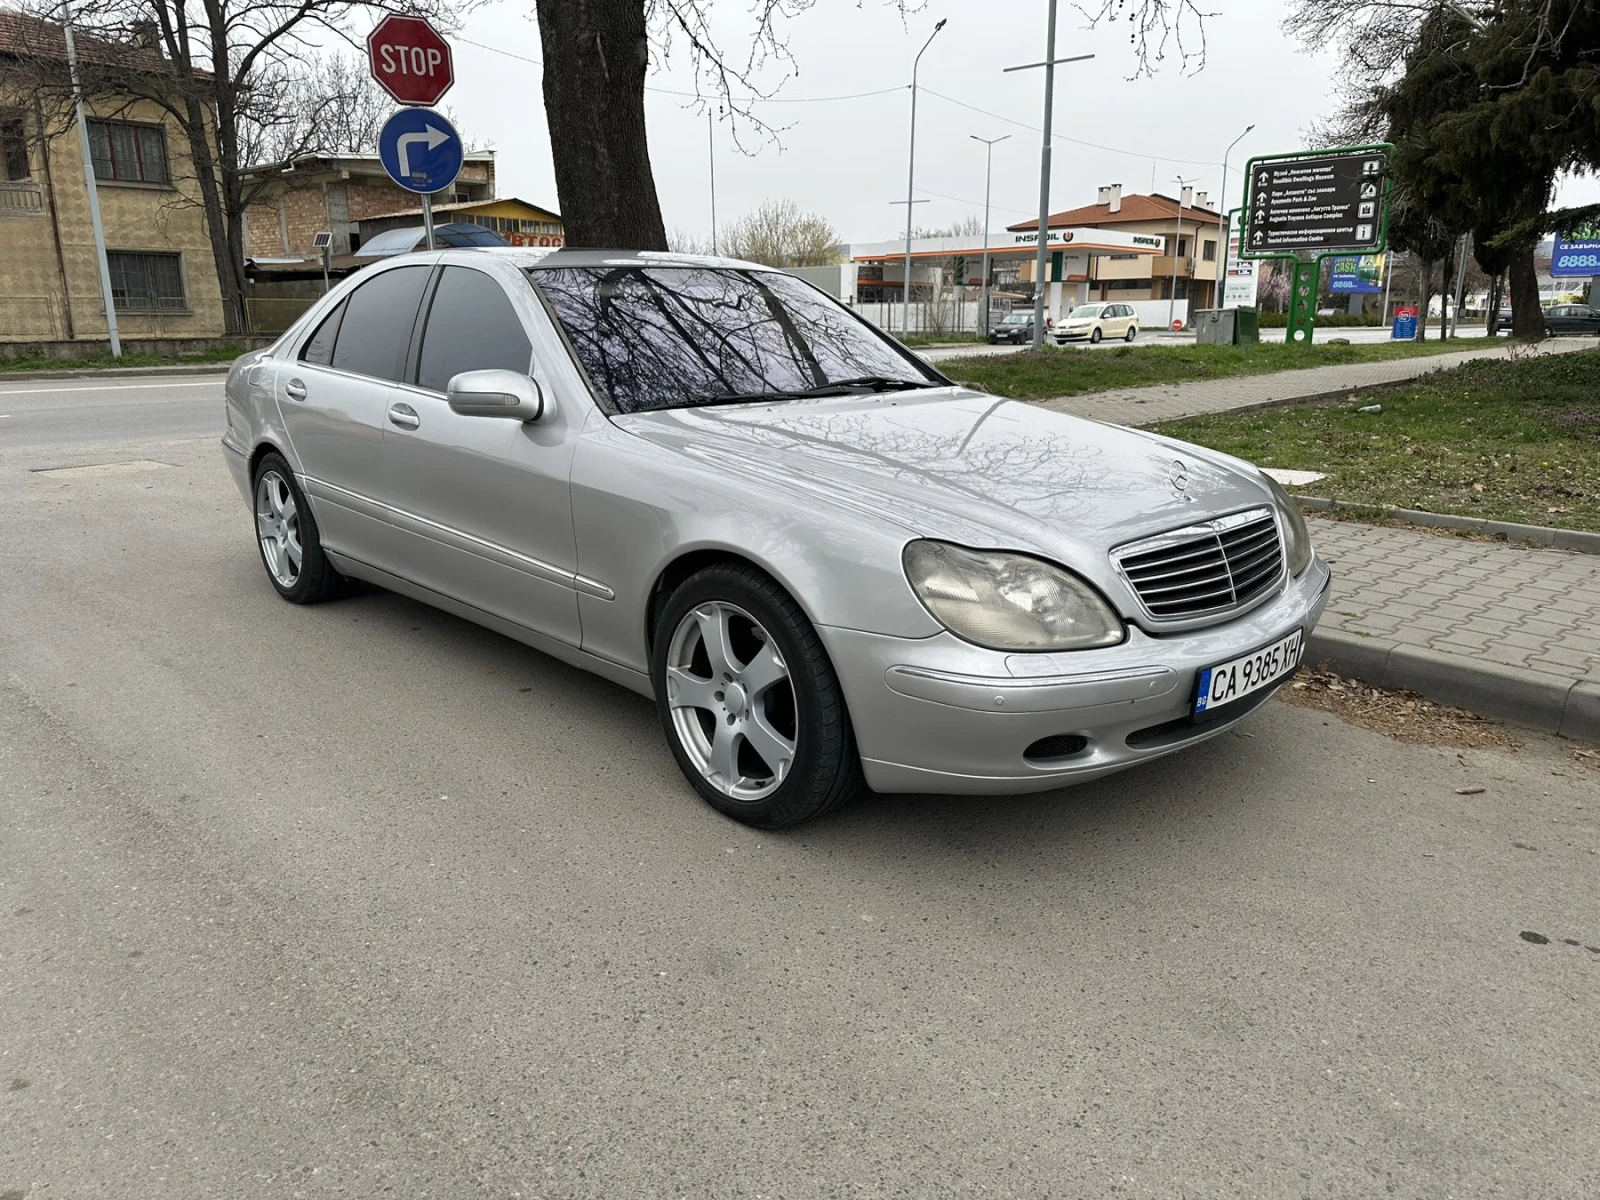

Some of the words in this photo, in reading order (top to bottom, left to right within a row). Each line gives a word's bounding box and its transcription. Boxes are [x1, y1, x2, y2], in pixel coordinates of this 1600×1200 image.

[380, 44, 442, 76] STOP
[1334, 262, 1357, 273] CASH
[1212, 665, 1236, 702] CA
[1242, 646, 1280, 692] 9385
[1280, 635, 1300, 672] XH
[1196, 696, 1207, 707] BG
